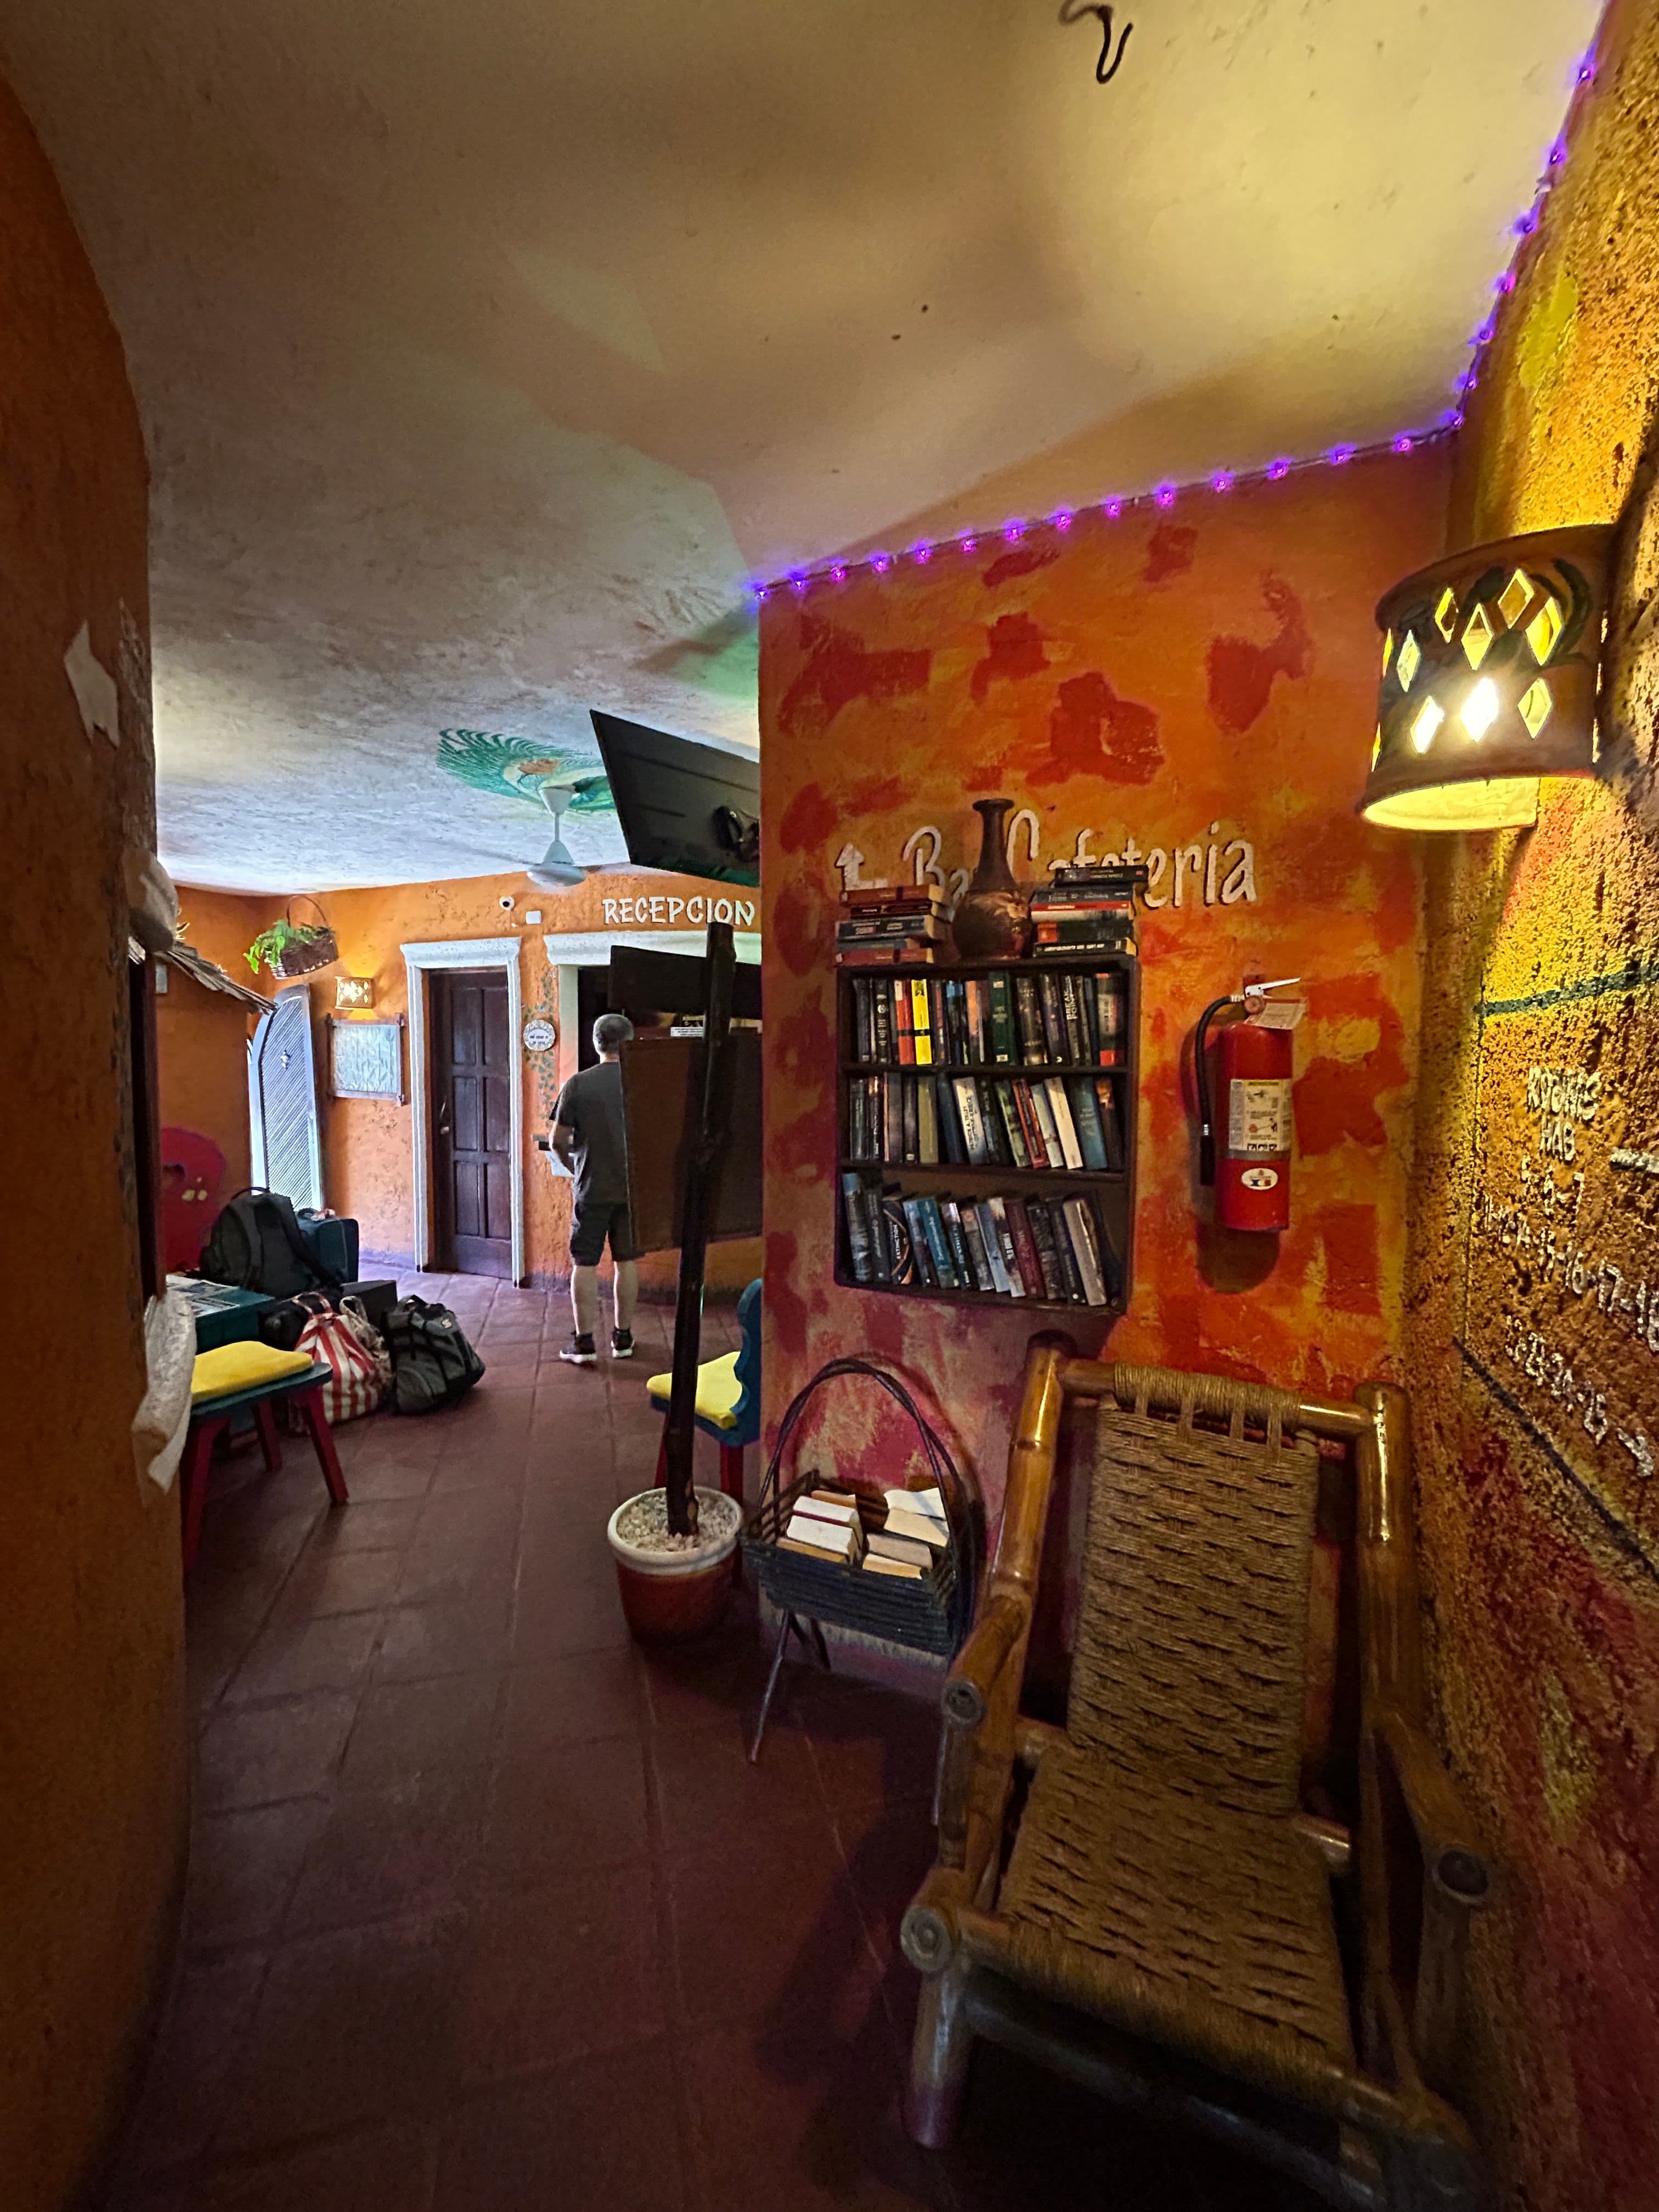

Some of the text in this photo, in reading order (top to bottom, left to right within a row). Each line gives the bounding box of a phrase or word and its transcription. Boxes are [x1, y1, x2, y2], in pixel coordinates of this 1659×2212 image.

[1006, 809, 1257, 907] Cfteria
[602, 895, 755, 926] RECEPCION
[1064, 989, 1073, 1020] BREAK
[1540, 1115, 1575, 1161] HAB
[892, 1224, 901, 1260] EXTINCTION
